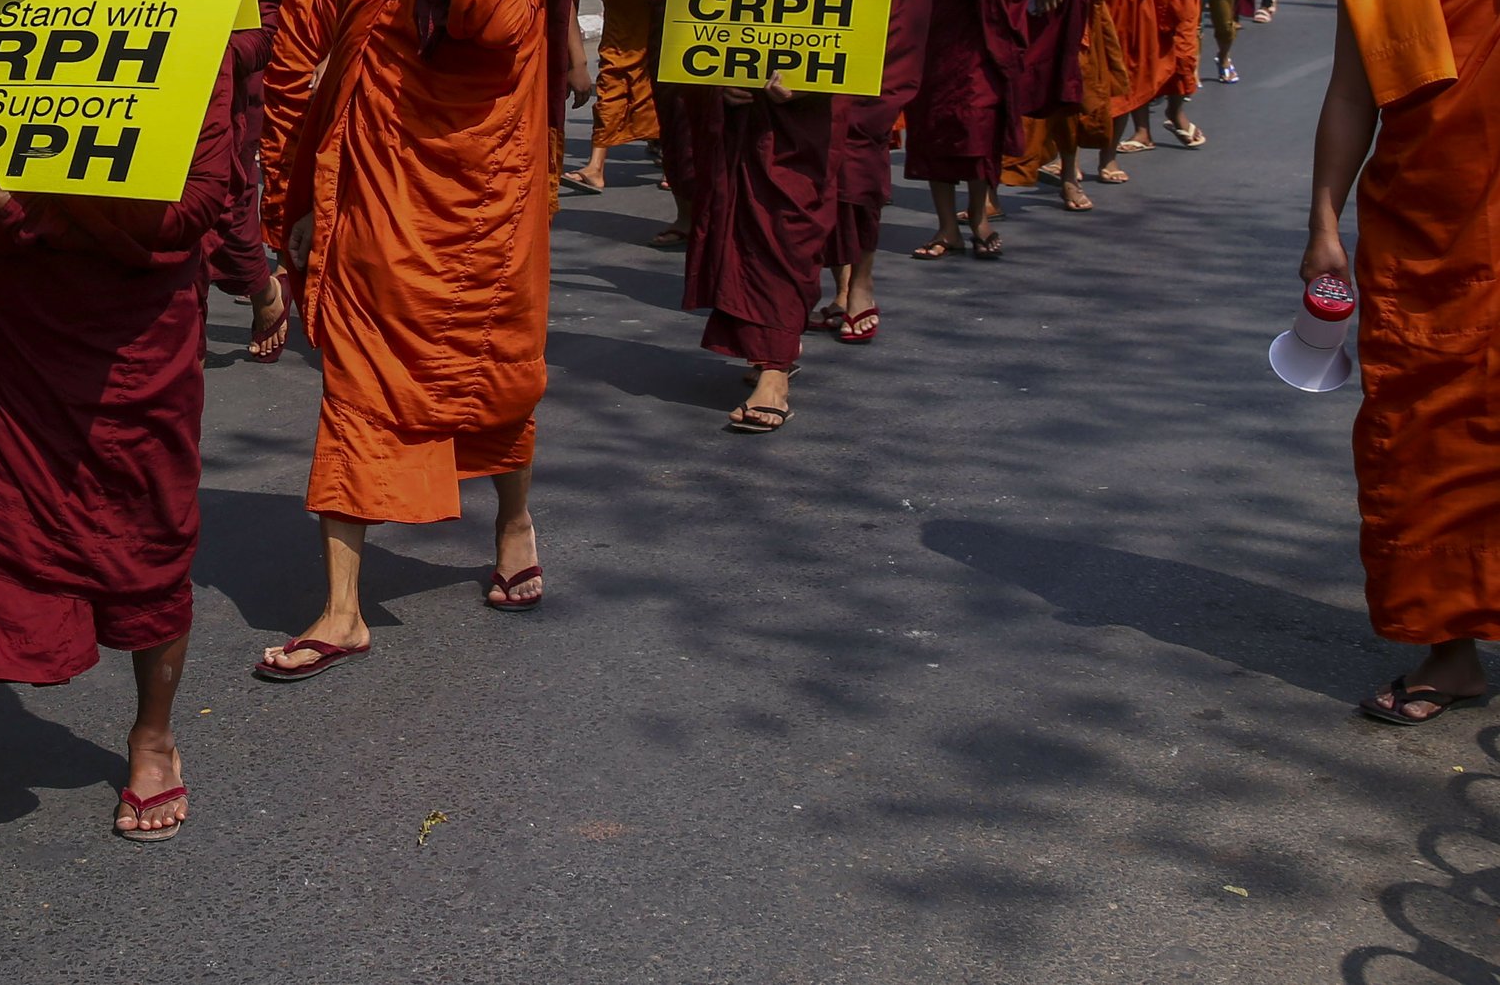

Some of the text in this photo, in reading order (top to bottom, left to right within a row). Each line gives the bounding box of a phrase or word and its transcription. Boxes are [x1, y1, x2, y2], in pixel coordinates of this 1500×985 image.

[106, 1, 179, 29] with
[693, 25, 842, 49] We Support
[682, 45, 847, 85] CRPH
